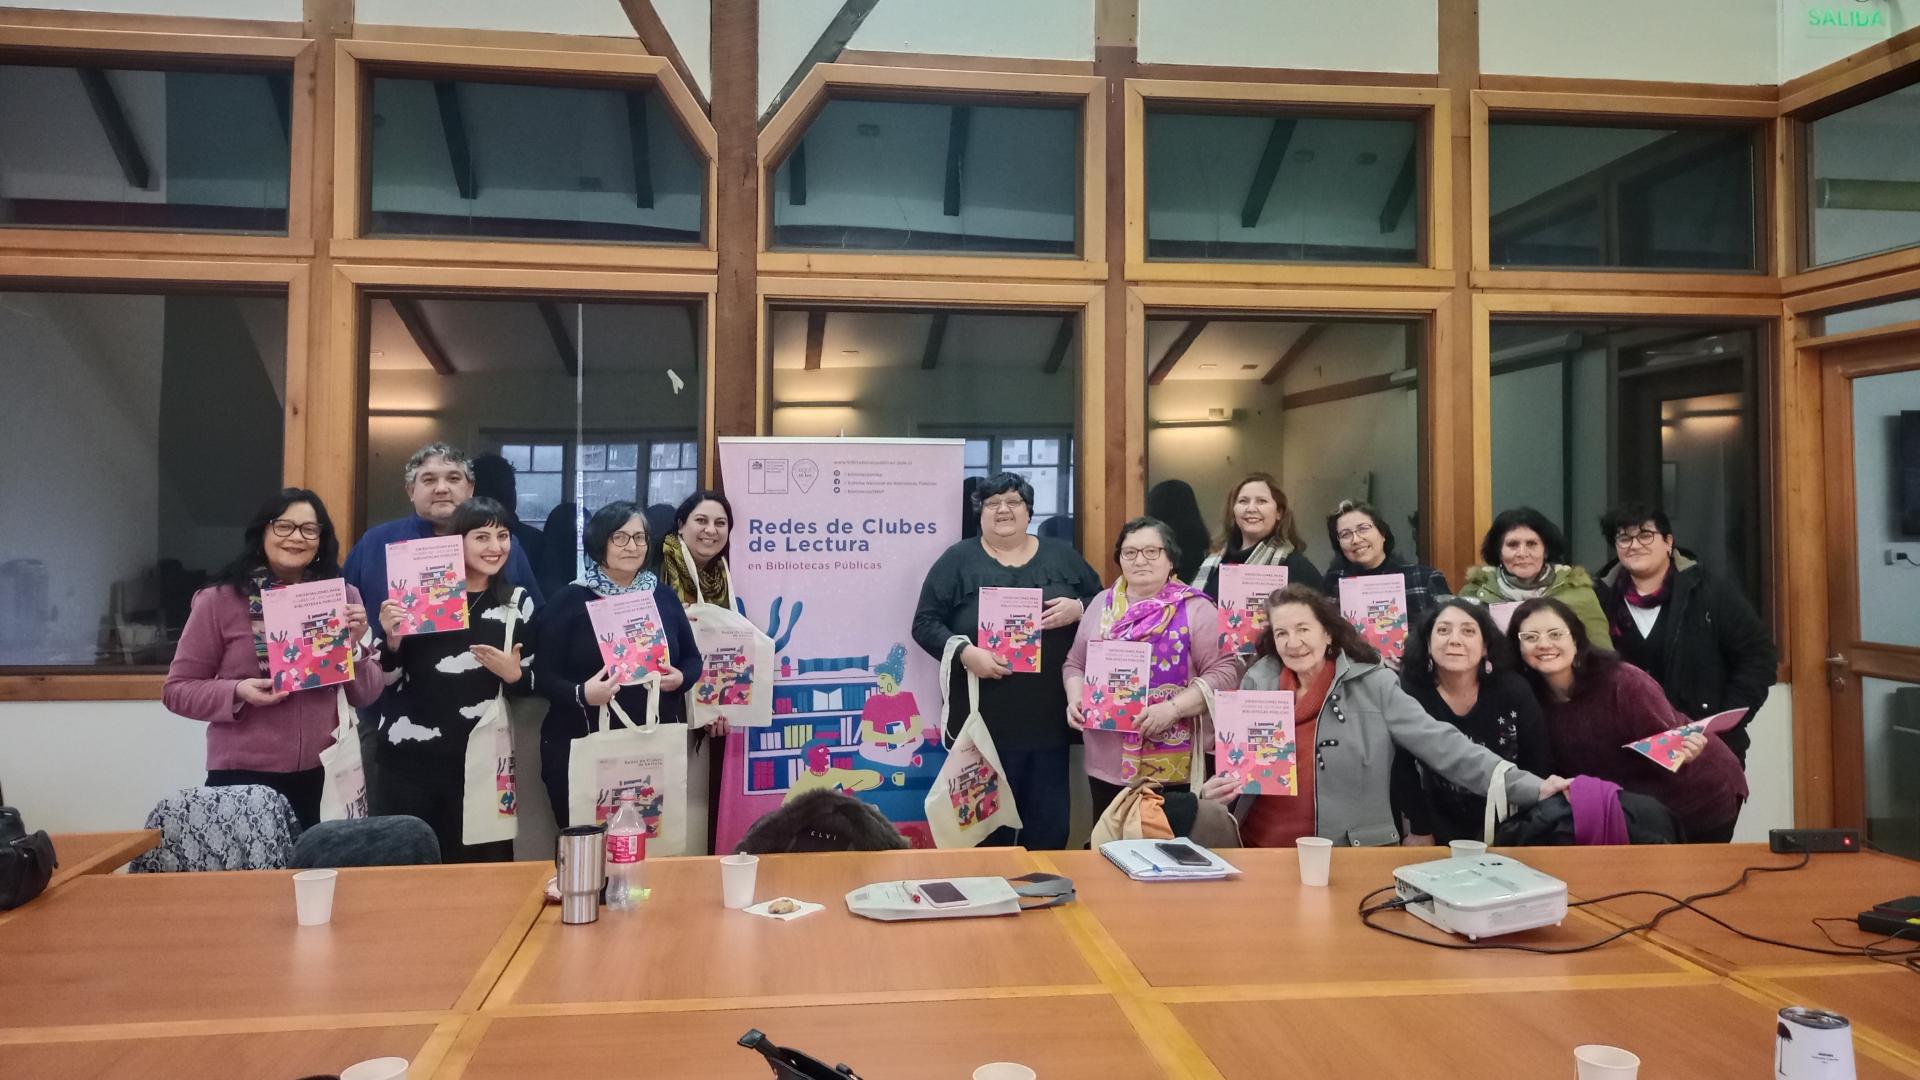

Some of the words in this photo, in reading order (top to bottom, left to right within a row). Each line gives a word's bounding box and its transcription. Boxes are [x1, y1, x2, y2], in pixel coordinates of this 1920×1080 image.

[1808, 9, 1884, 27] SALIDA
[749, 518, 818, 535] Redes
[826, 518, 854, 535] de
[862, 518, 937, 535] Clubes
[748, 536, 777, 552] de
[785, 536, 870, 552] Lectura
[747, 562, 762, 571] en
[766, 560, 831, 571] Bibliotecas
[834, 560, 882, 571] Públicas
